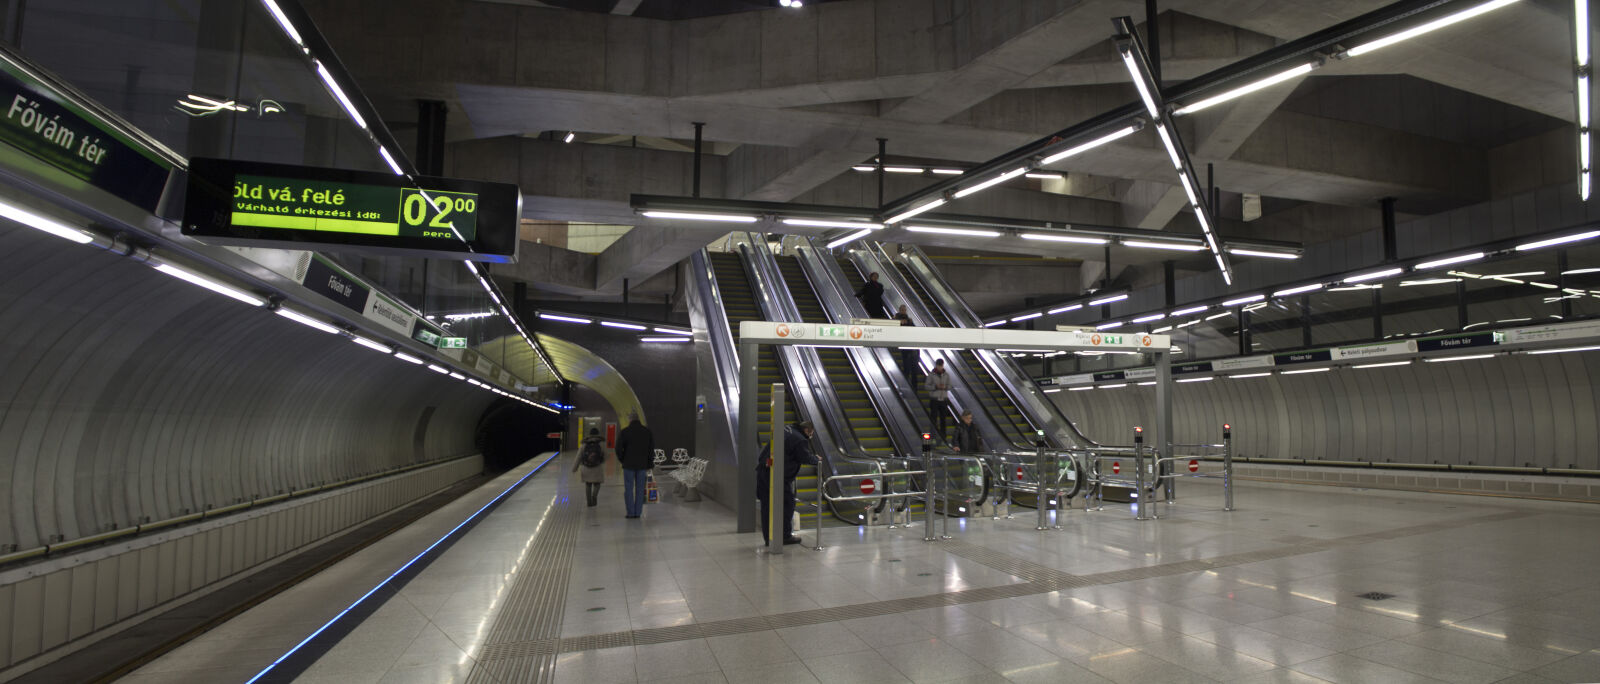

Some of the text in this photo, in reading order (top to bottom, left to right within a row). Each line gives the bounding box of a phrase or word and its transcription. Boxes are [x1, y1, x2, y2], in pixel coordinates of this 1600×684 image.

[7, 94, 106, 165] Fővám tér
[268, 186, 296, 202] vá.
[302, 188, 345, 205] felé
[237, 202, 290, 213] Várható
[294, 206, 351, 218] érkezési
[403, 193, 454, 228] 02
[423, 231, 452, 239] perc
